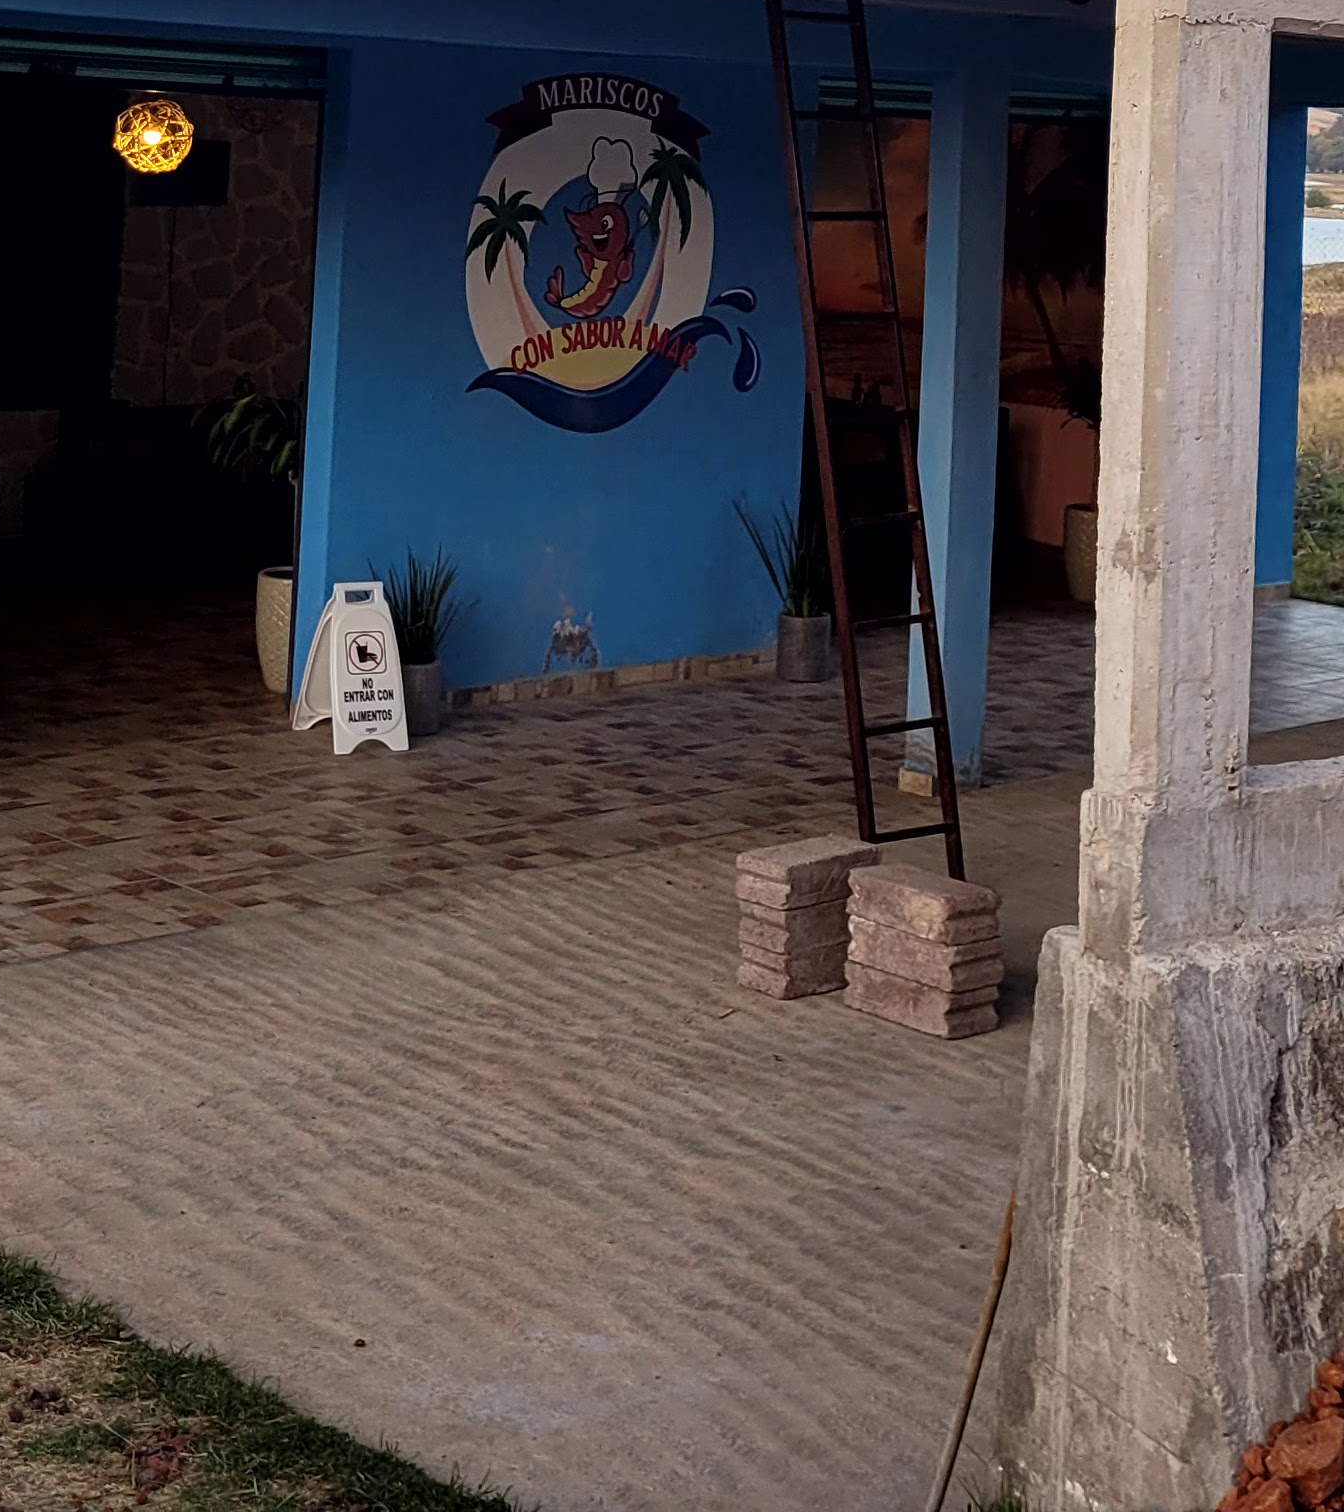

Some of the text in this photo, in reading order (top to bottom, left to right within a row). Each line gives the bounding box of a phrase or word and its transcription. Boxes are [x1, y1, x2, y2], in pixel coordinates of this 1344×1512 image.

[538, 76, 664, 117] MARISCOS
[511, 316, 697, 375] CON SABOR A MAR
[362, 678, 374, 689] NO
[344, 689, 394, 703] ENTRAR CON
[348, 710, 393, 722] ALIMENTOS
